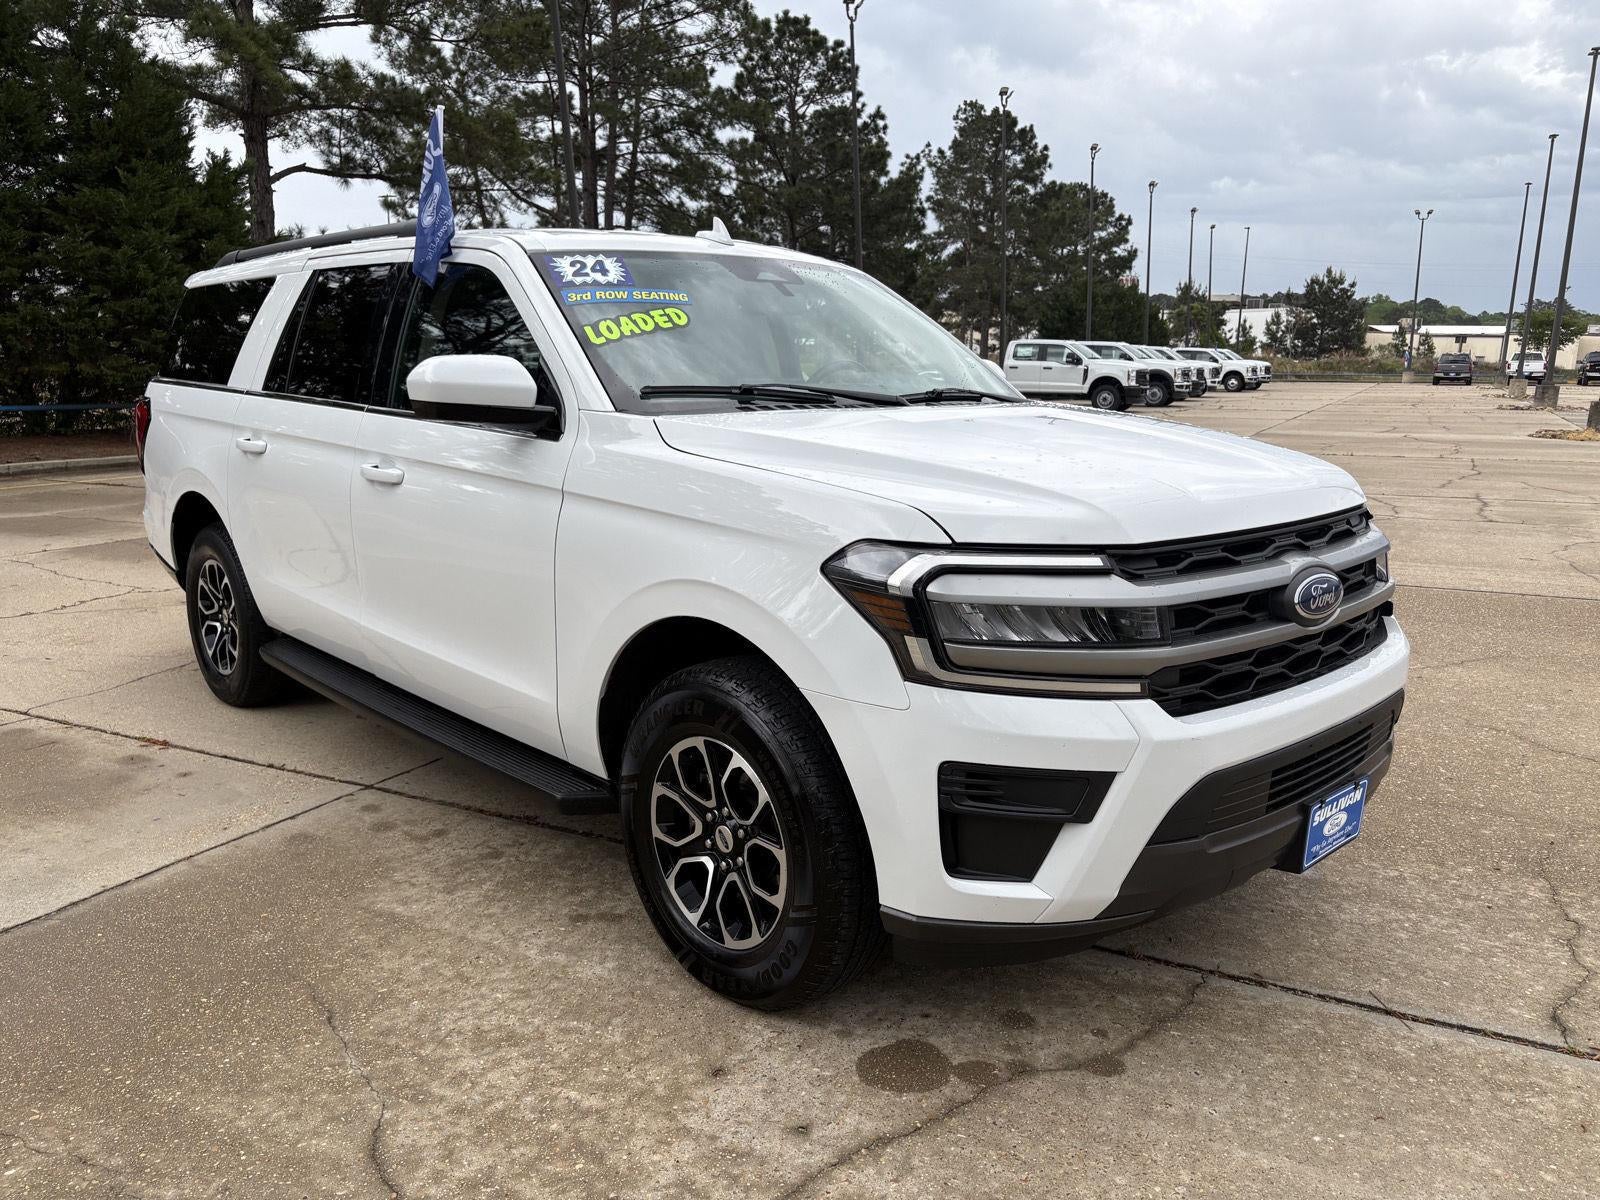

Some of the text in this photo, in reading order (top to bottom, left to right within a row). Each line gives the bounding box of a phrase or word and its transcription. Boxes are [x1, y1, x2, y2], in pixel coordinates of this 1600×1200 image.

[569, 259, 610, 278] 24
[567, 291, 689, 302] 3rd ROW SEATING
[584, 307, 688, 345] LOADED
[1310, 583, 1335, 609] Ford
[1312, 787, 1364, 827] SULLIVAN
